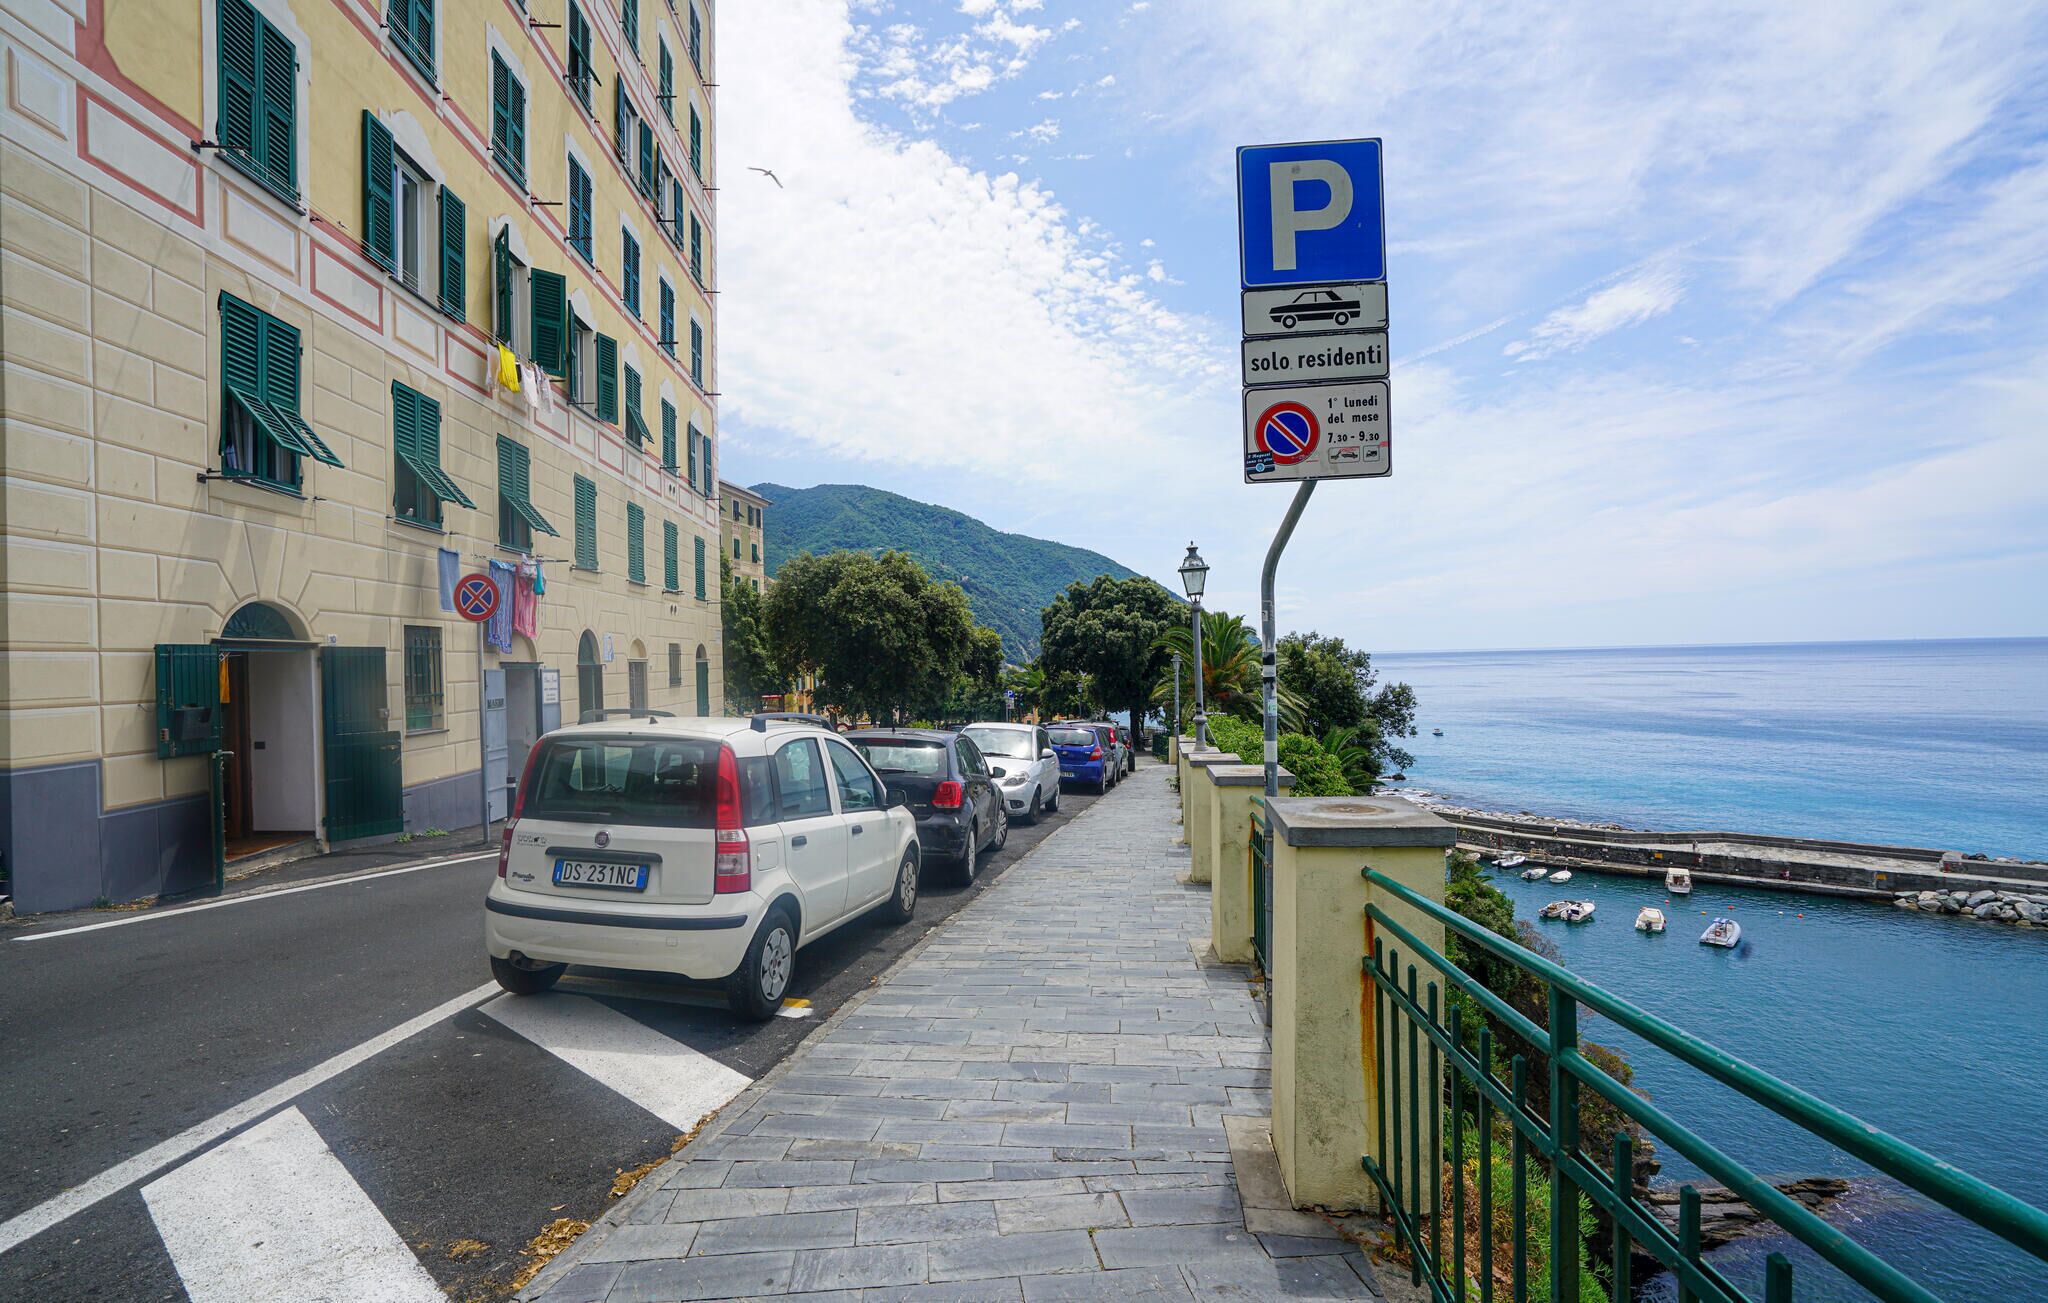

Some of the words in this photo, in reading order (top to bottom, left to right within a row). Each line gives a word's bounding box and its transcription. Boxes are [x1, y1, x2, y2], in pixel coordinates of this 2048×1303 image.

[1269, 159, 1354, 271] P
[1251, 351, 1290, 372] solo
[1298, 344, 1382, 369] residenti
[1327, 412, 1345, 424] del
[1351, 413, 1379, 423] mese
[1327, 432, 1348, 444] 7.30
[1358, 430, 1380, 442] 9.30
[562, 862, 582, 881] DS
[586, 864, 636, 885] 231NC
